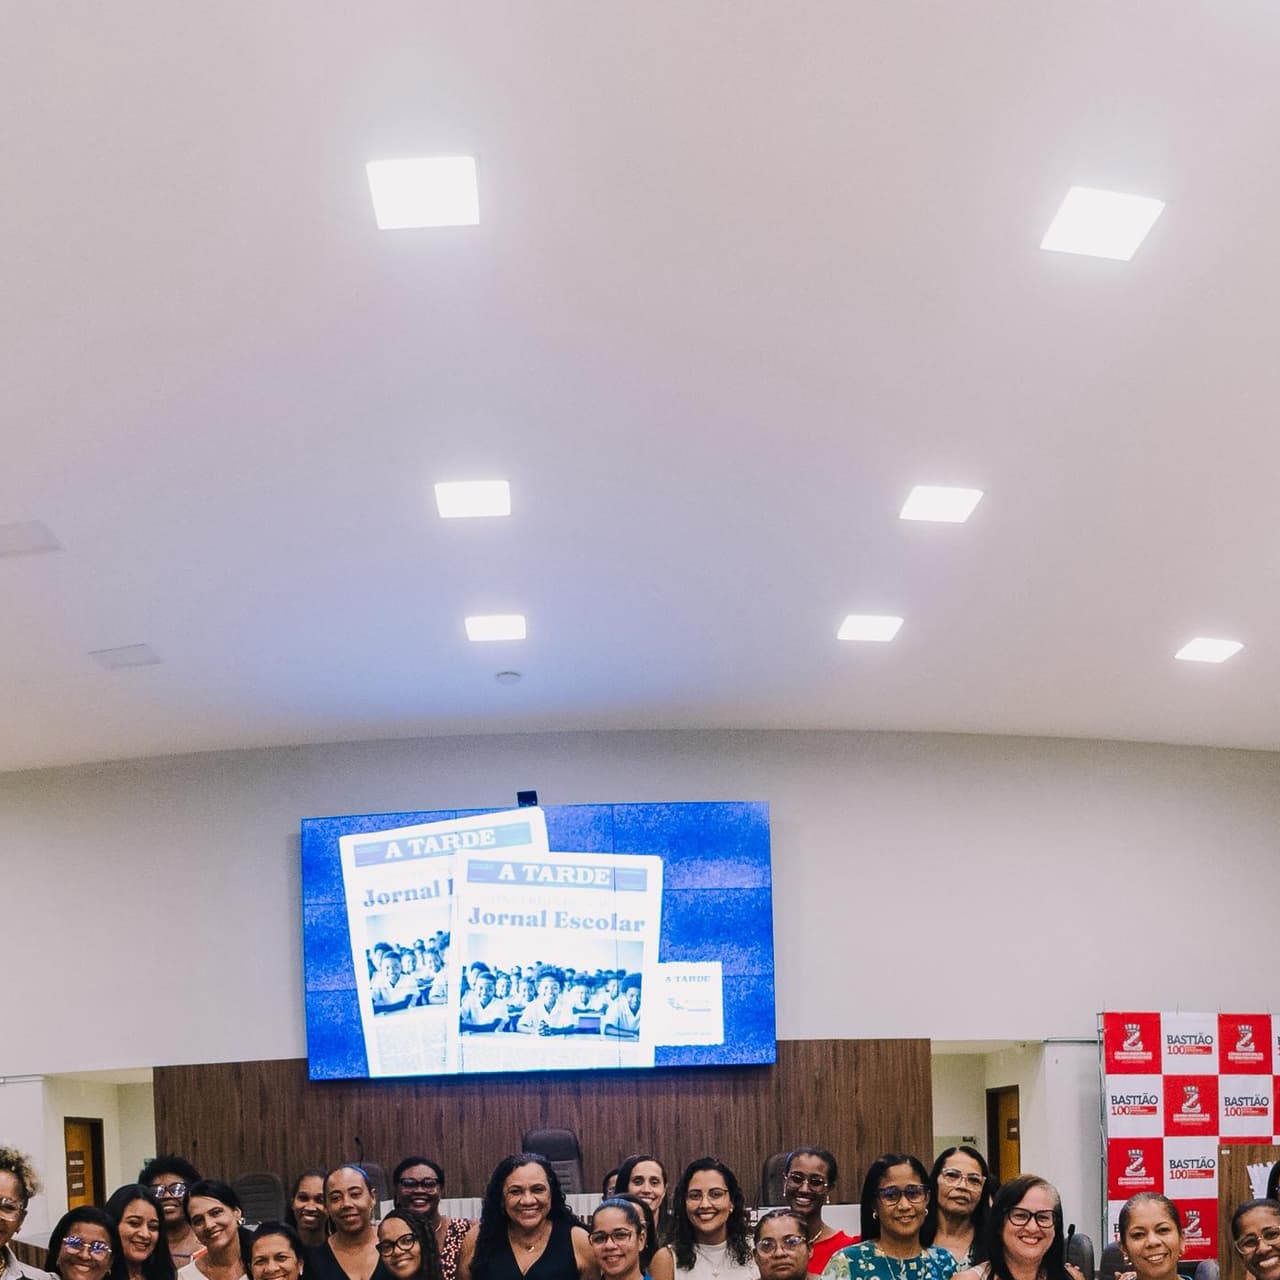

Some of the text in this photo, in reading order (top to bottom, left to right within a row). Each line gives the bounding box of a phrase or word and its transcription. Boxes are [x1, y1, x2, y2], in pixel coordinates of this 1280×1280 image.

[385, 829, 496, 859] A TARDE
[498, 864, 610, 885] A TARDE
[363, 879, 441, 907] Jornal
[468, 907, 646, 932] Jornal Escolar
[1166, 1032, 1214, 1045] BASTIÃO
[1167, 1046, 1185, 1055] 100
[1111, 1093, 1159, 1105] BASTIÃO
[1224, 1094, 1270, 1106] BASTIÃO
[1112, 1106, 1130, 1115] 100
[1224, 1107, 1242, 1116] 100
[1169, 1156, 1216, 1169] BASTIÃO
[1170, 1170, 1187, 1179] 100
